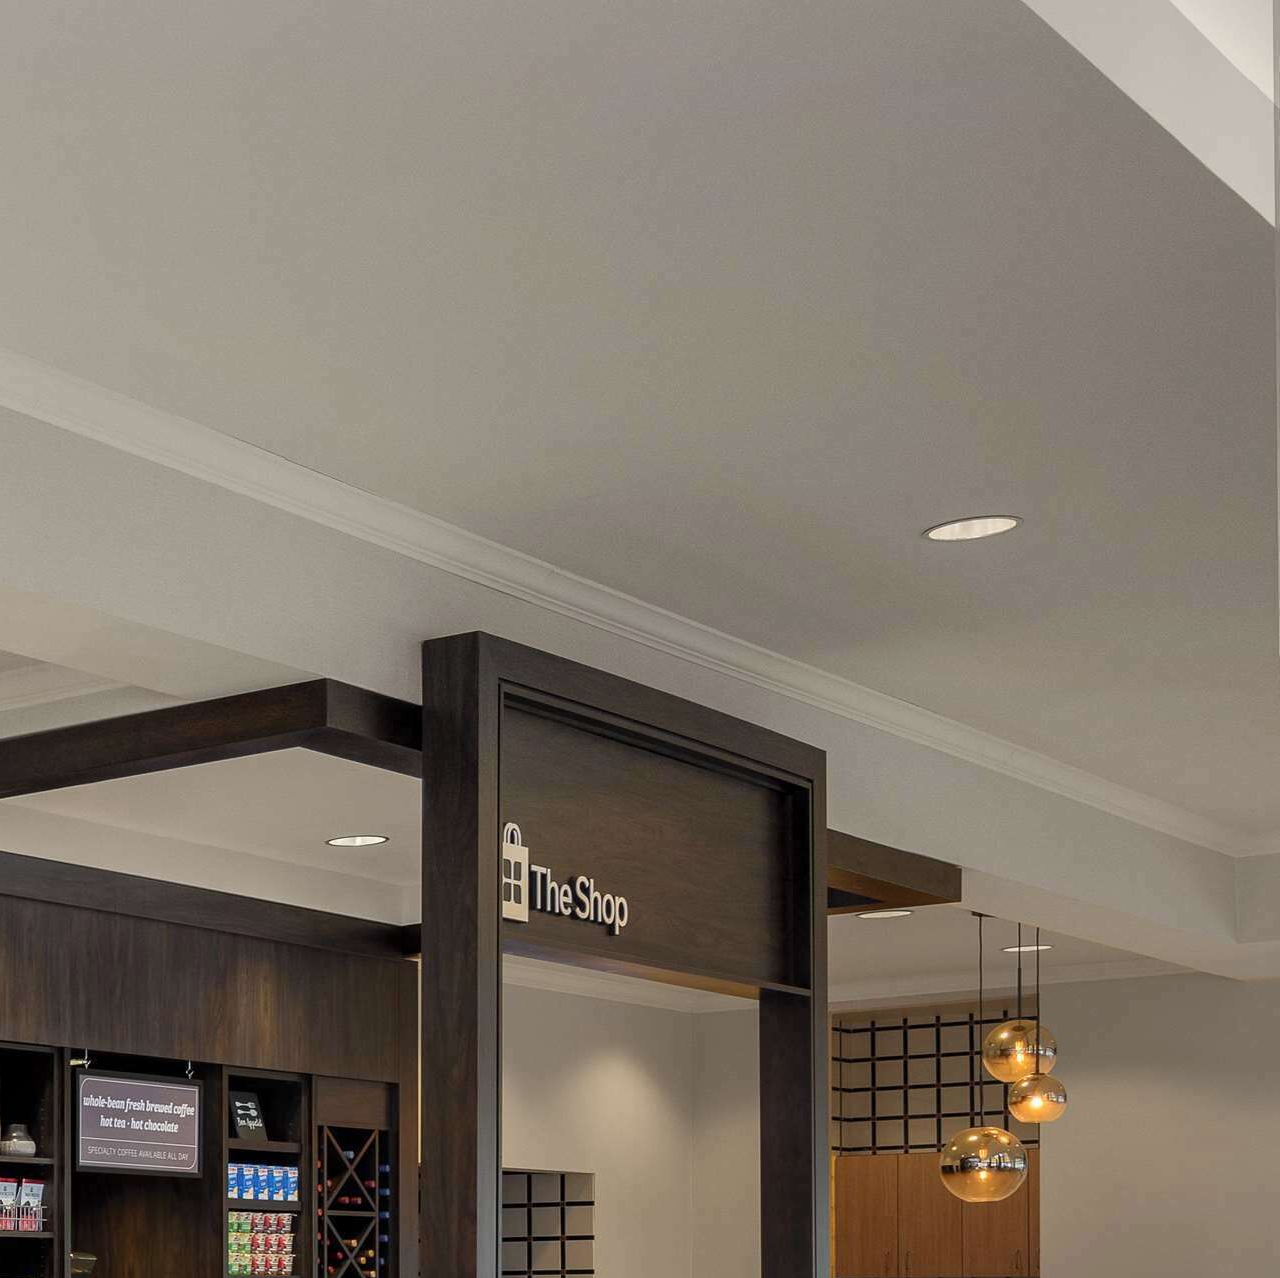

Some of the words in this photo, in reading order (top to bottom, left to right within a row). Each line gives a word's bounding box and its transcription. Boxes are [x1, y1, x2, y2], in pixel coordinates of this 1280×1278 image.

[530, 864, 572, 916] The
[575, 875, 629, 935] Shop
[83, 1095, 125, 1109] whole-bean
[125, 1098, 145, 1112] fresh
[146, 1100, 173, 1114] brewed
[173, 1103, 195, 1117] coffee
[100, 1115, 113, 1127] hot
[114, 1118, 126, 1128] tea
[131, 1118, 143, 1130] hot
[144, 1119, 179, 1133] chocolate
[88, 1146, 117, 1155] SPECIALTY
[117, 1148, 138, 1158] COFFEE
[139, 1150, 167, 1160] AVAILABLE
[167, 1152, 178, 1161] ALL
[178, 1152, 189, 1161] DAY
